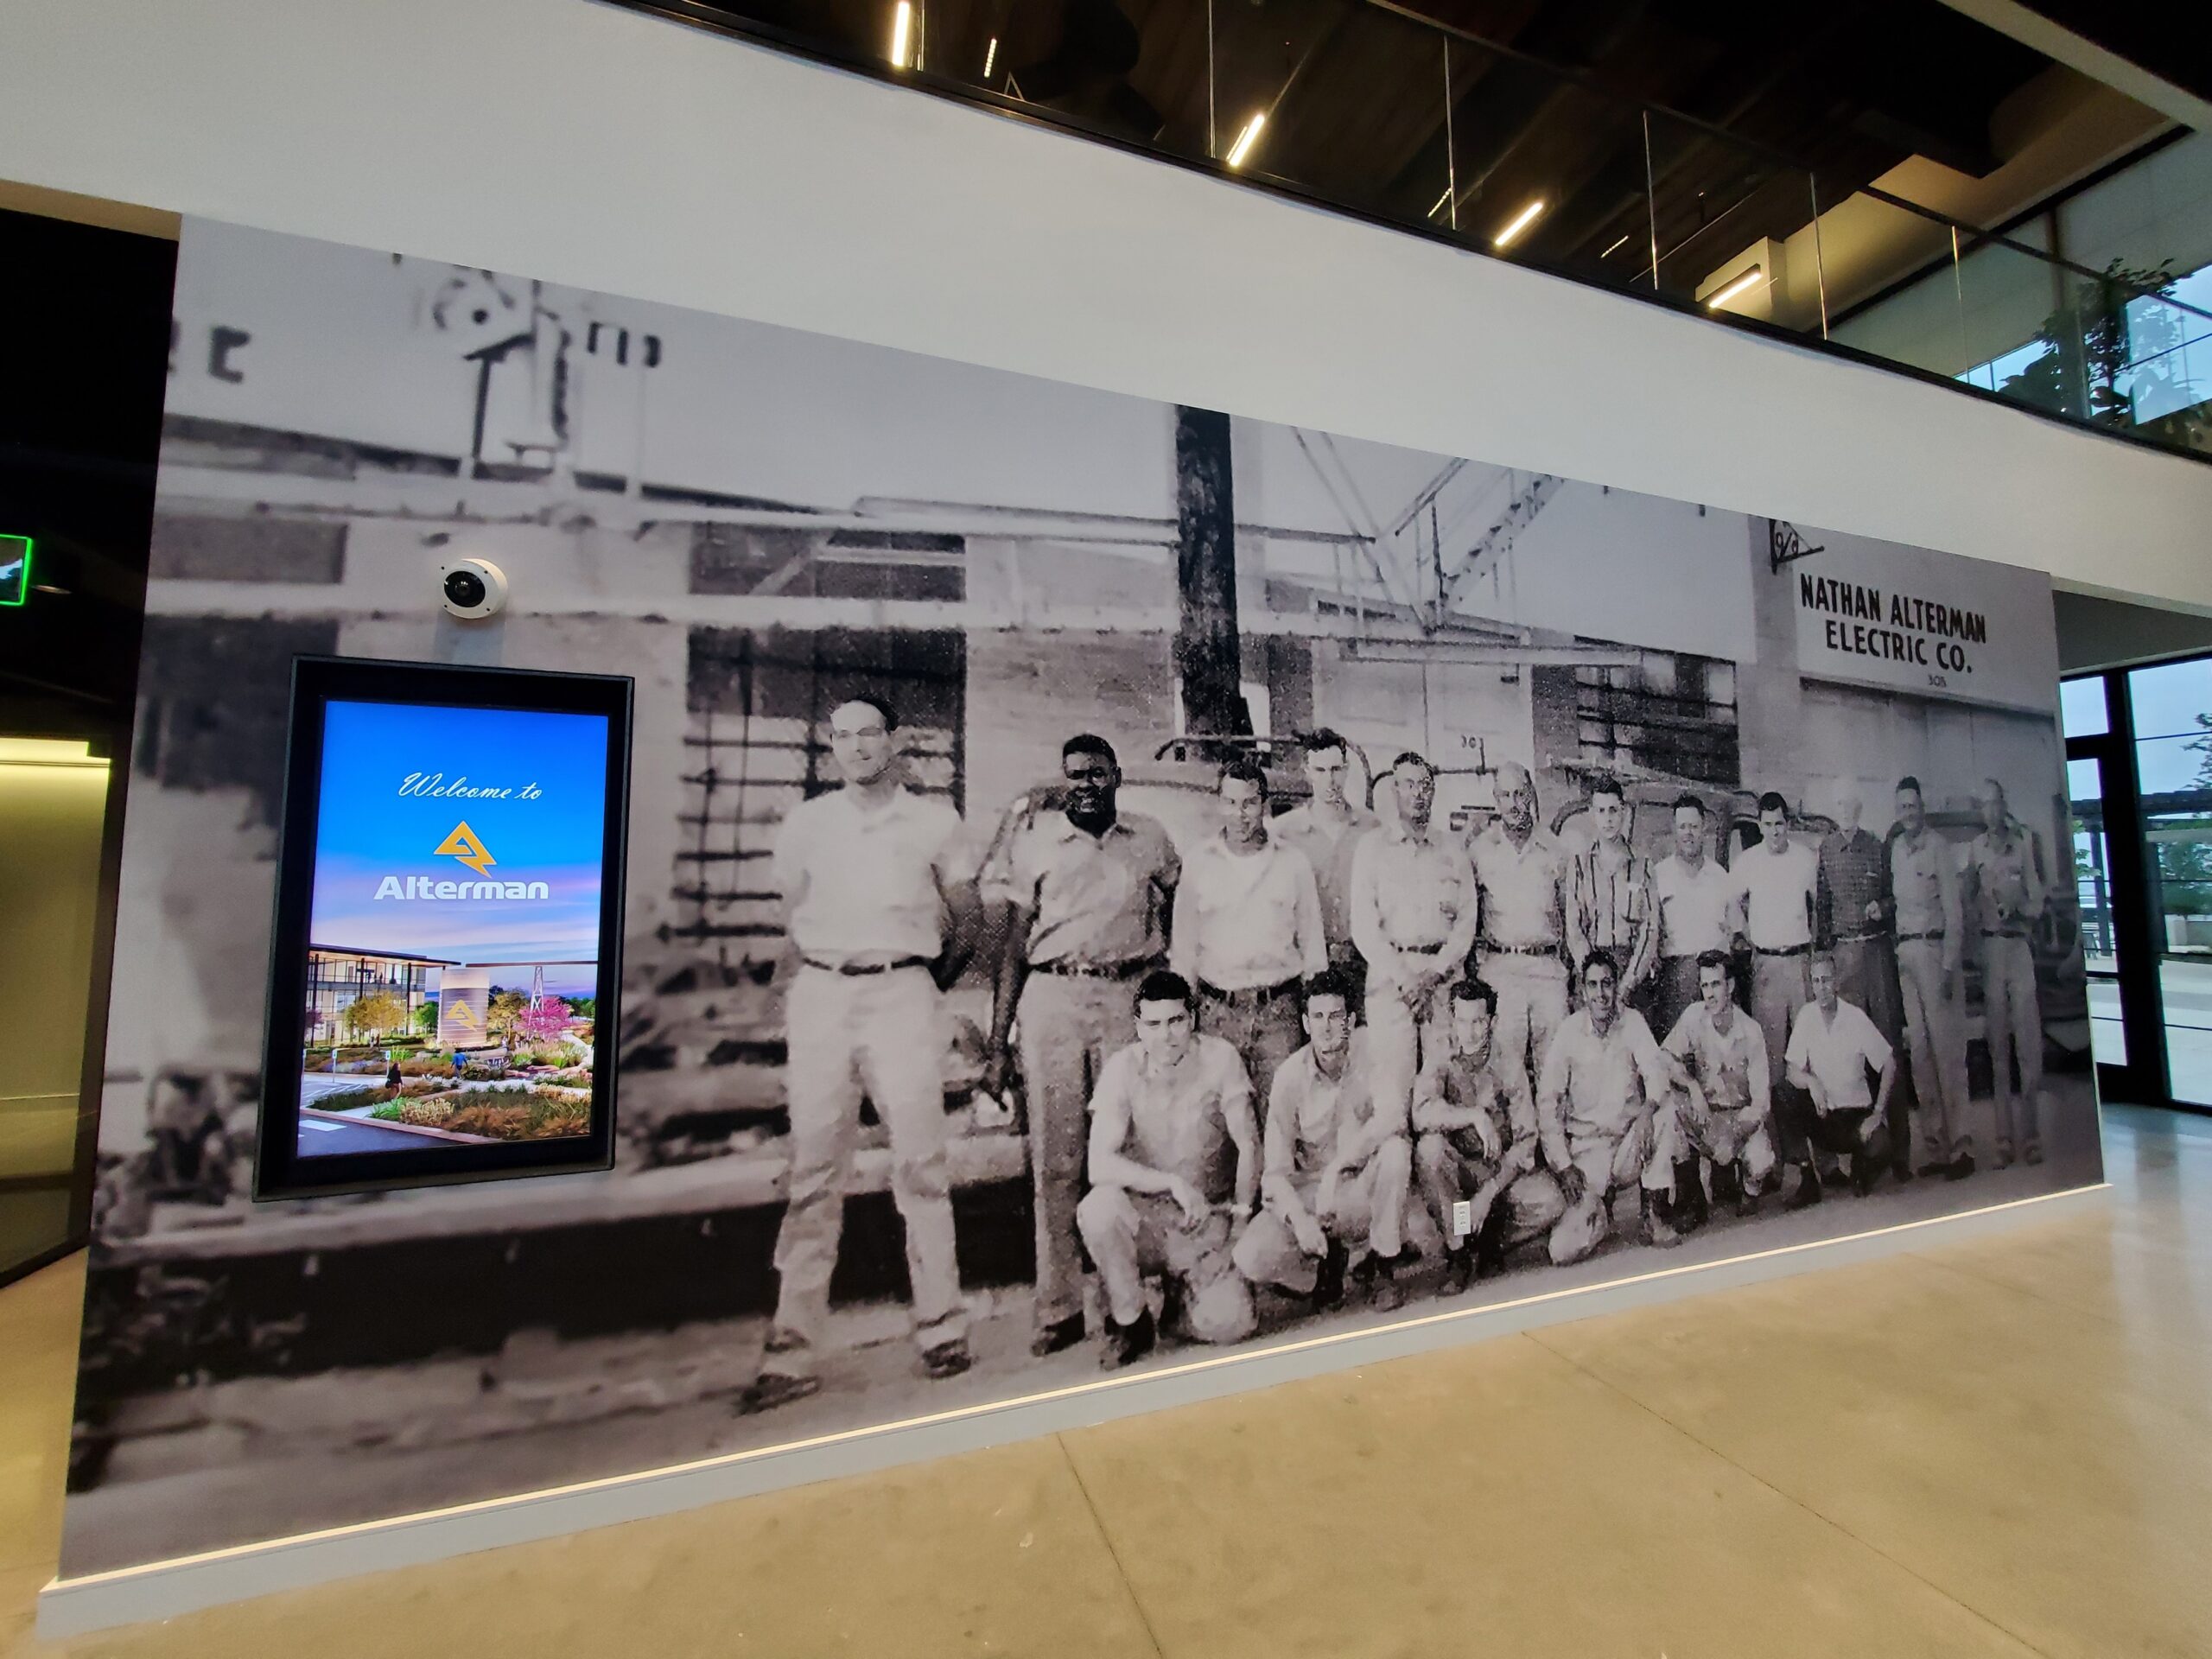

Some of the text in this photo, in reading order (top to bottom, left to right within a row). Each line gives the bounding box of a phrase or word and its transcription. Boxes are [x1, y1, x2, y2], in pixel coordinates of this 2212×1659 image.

[1800, 573, 1986, 644] NATHAN ALTERMAN
[1826, 620, 1972, 674] ELECTRIC CO.
[398, 772, 543, 800] Welcome to
[373, 876, 549, 899] Alterman
